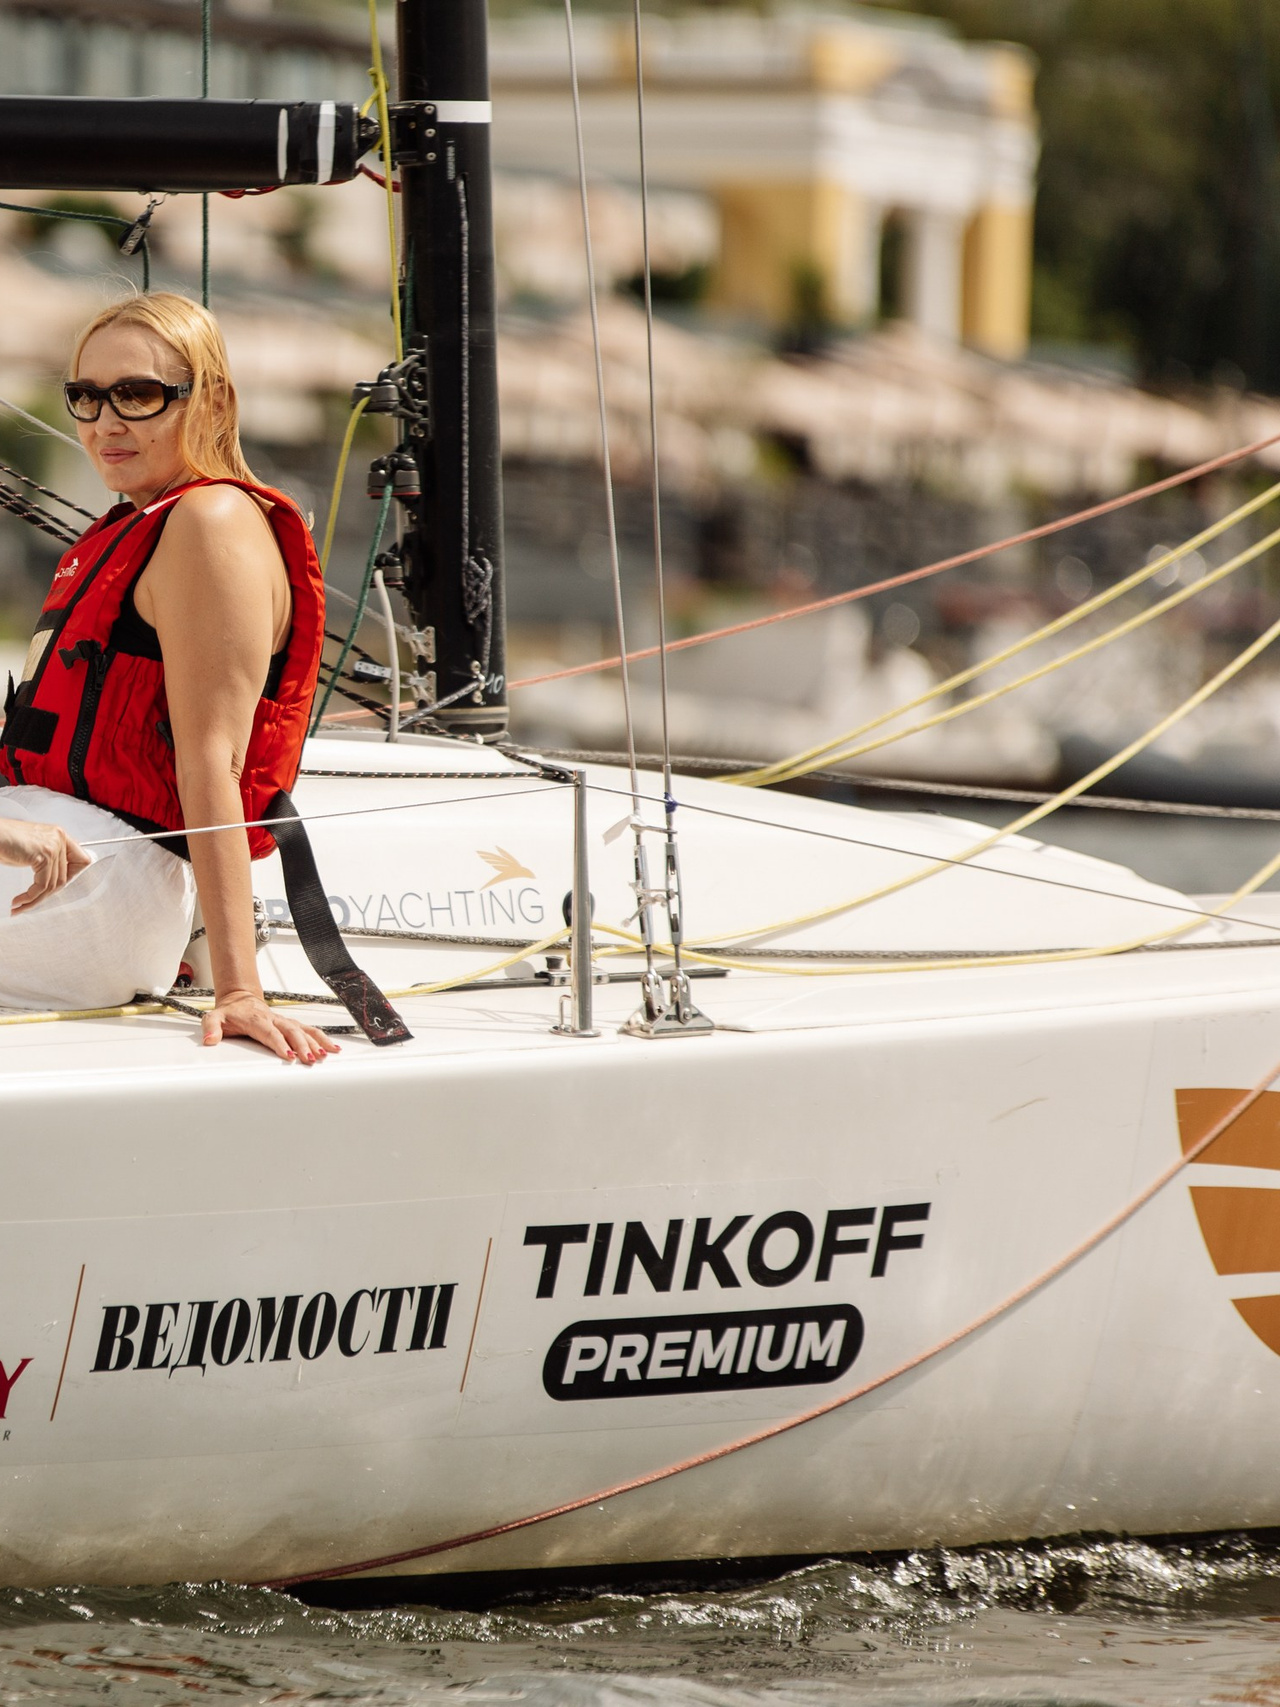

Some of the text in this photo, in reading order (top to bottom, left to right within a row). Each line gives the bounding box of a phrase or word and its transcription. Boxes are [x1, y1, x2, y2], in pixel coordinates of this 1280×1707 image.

[265, 887, 545, 936] PYACHTING
[523, 1202, 932, 1299] TINKOFF
[88, 1282, 459, 1379] ВЕДОМОСТИ
[561, 1318, 848, 1385] PREMIUM
